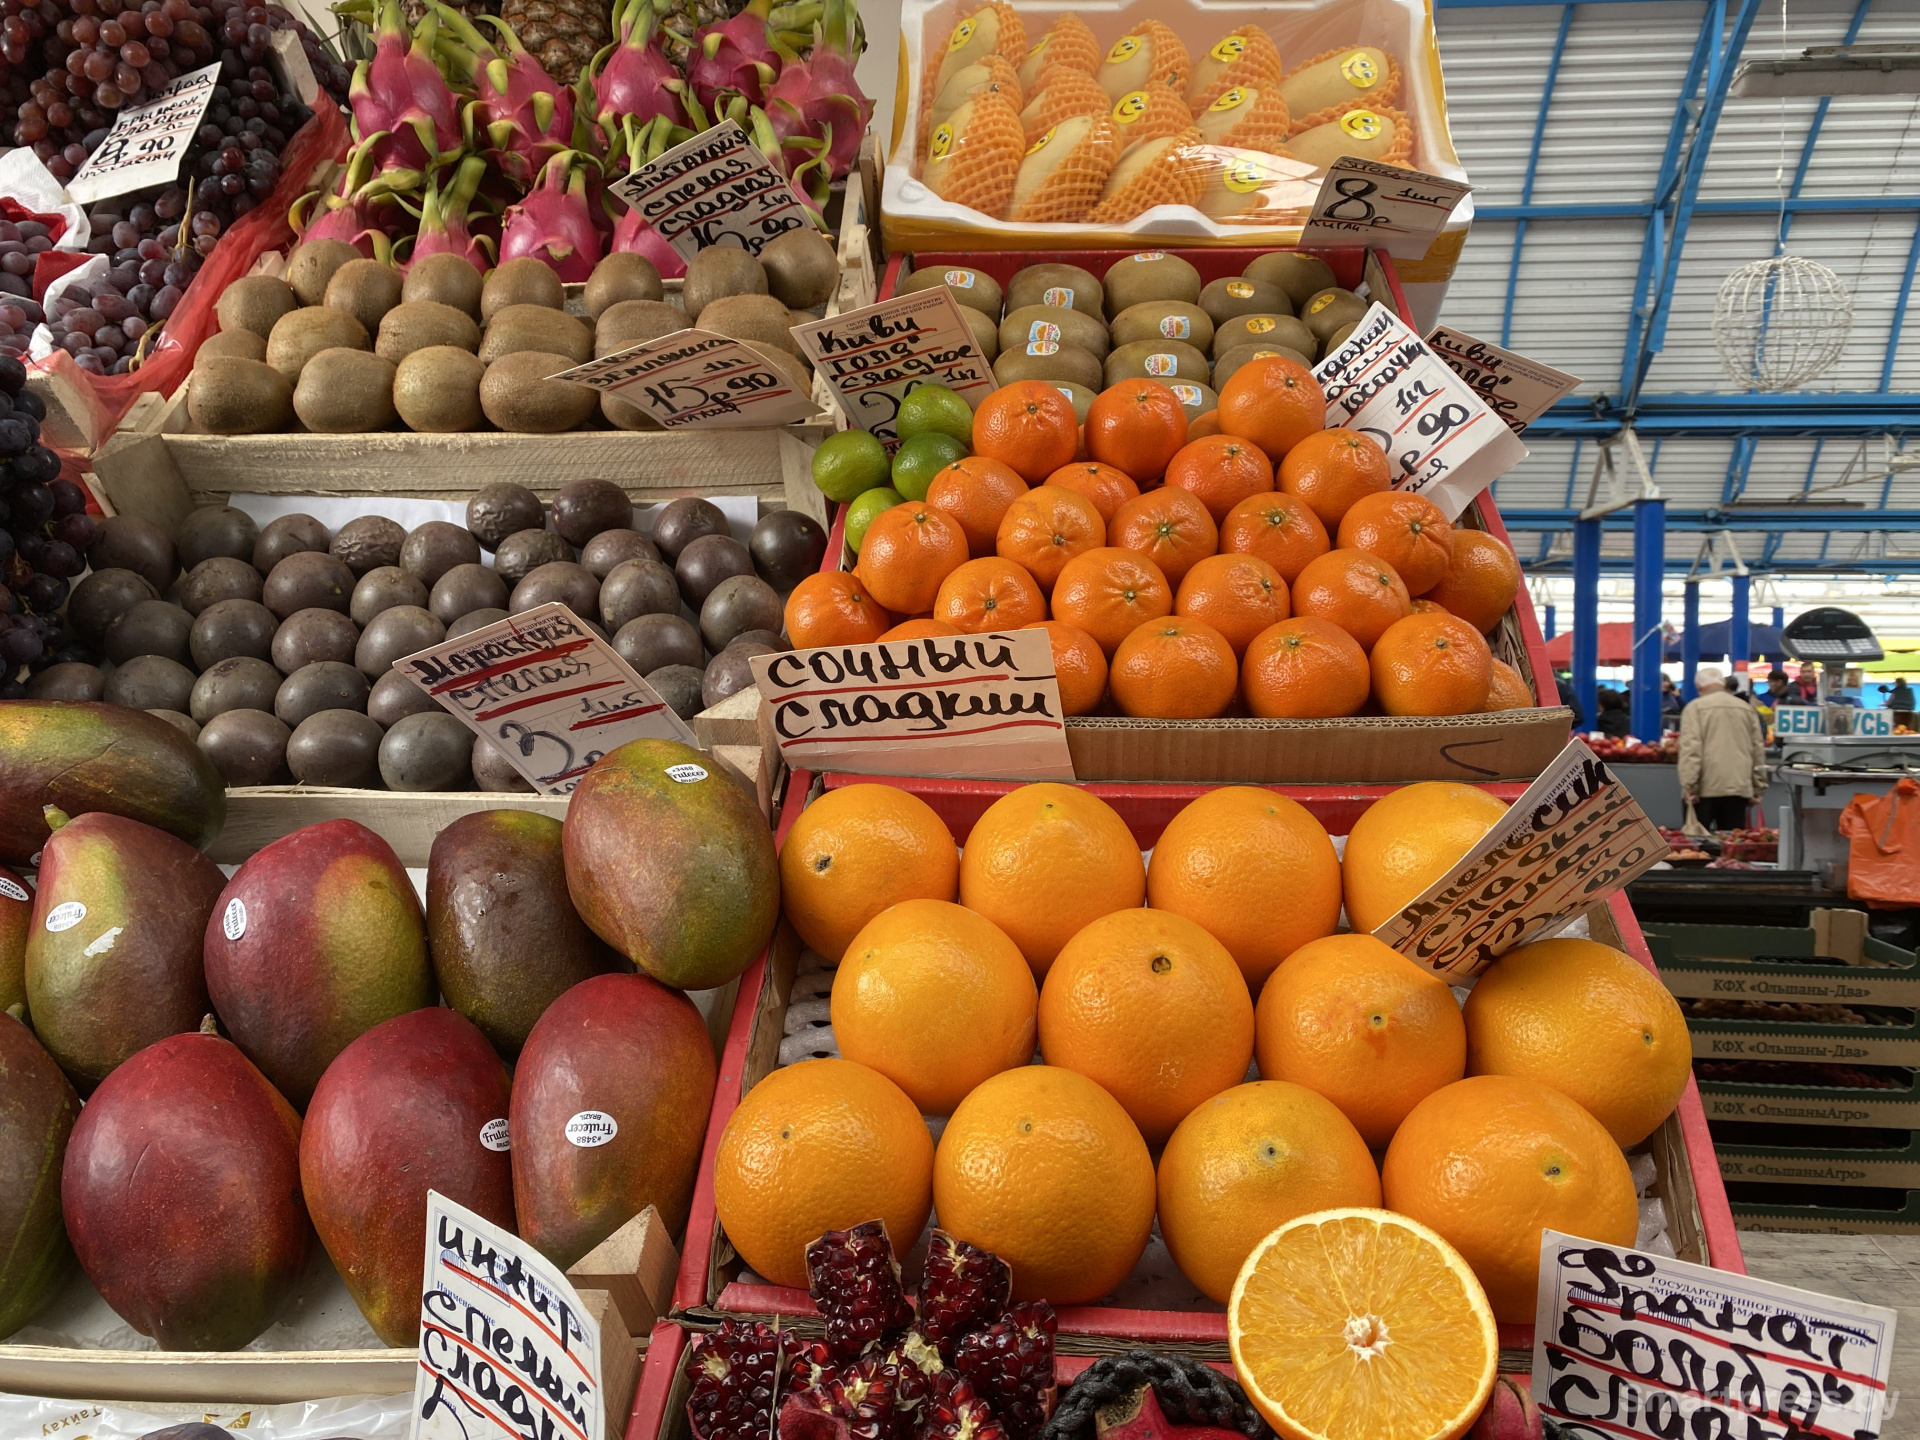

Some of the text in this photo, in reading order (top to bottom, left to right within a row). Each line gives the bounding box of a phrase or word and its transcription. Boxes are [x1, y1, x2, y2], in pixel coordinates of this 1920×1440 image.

[139, 136, 174, 153] 90
[817, 315, 920, 353] Киви
[840, 344, 980, 389] сладкое
[726, 372, 778, 395] 90
[1417, 404, 1469, 445] 90
[1391, 758, 1615, 949] Апельсин
[1713, 979, 1871, 998] КФХ «Ольшаны-Два»
[1712, 1040, 1869, 1058] КФХ «Ольшаны-Два»
[579, 1113, 602, 1121] BRAZIL
[1713, 1102, 1870, 1122] КФХ «ОльшаныАгро»
[488, 1120, 506, 1130] #3488
[568, 1123, 614, 1135] Frutecer
[482, 1129, 510, 1143] Frutec
[576, 1136, 602, 1144] #3488
[1747, 1165, 1866, 1182] «ОльшаныАгро»
[1651, 1275, 1773, 1314] ГОСУДАРСТВЕННОЕ
[41, 1405, 101, 1437] Тайхау
